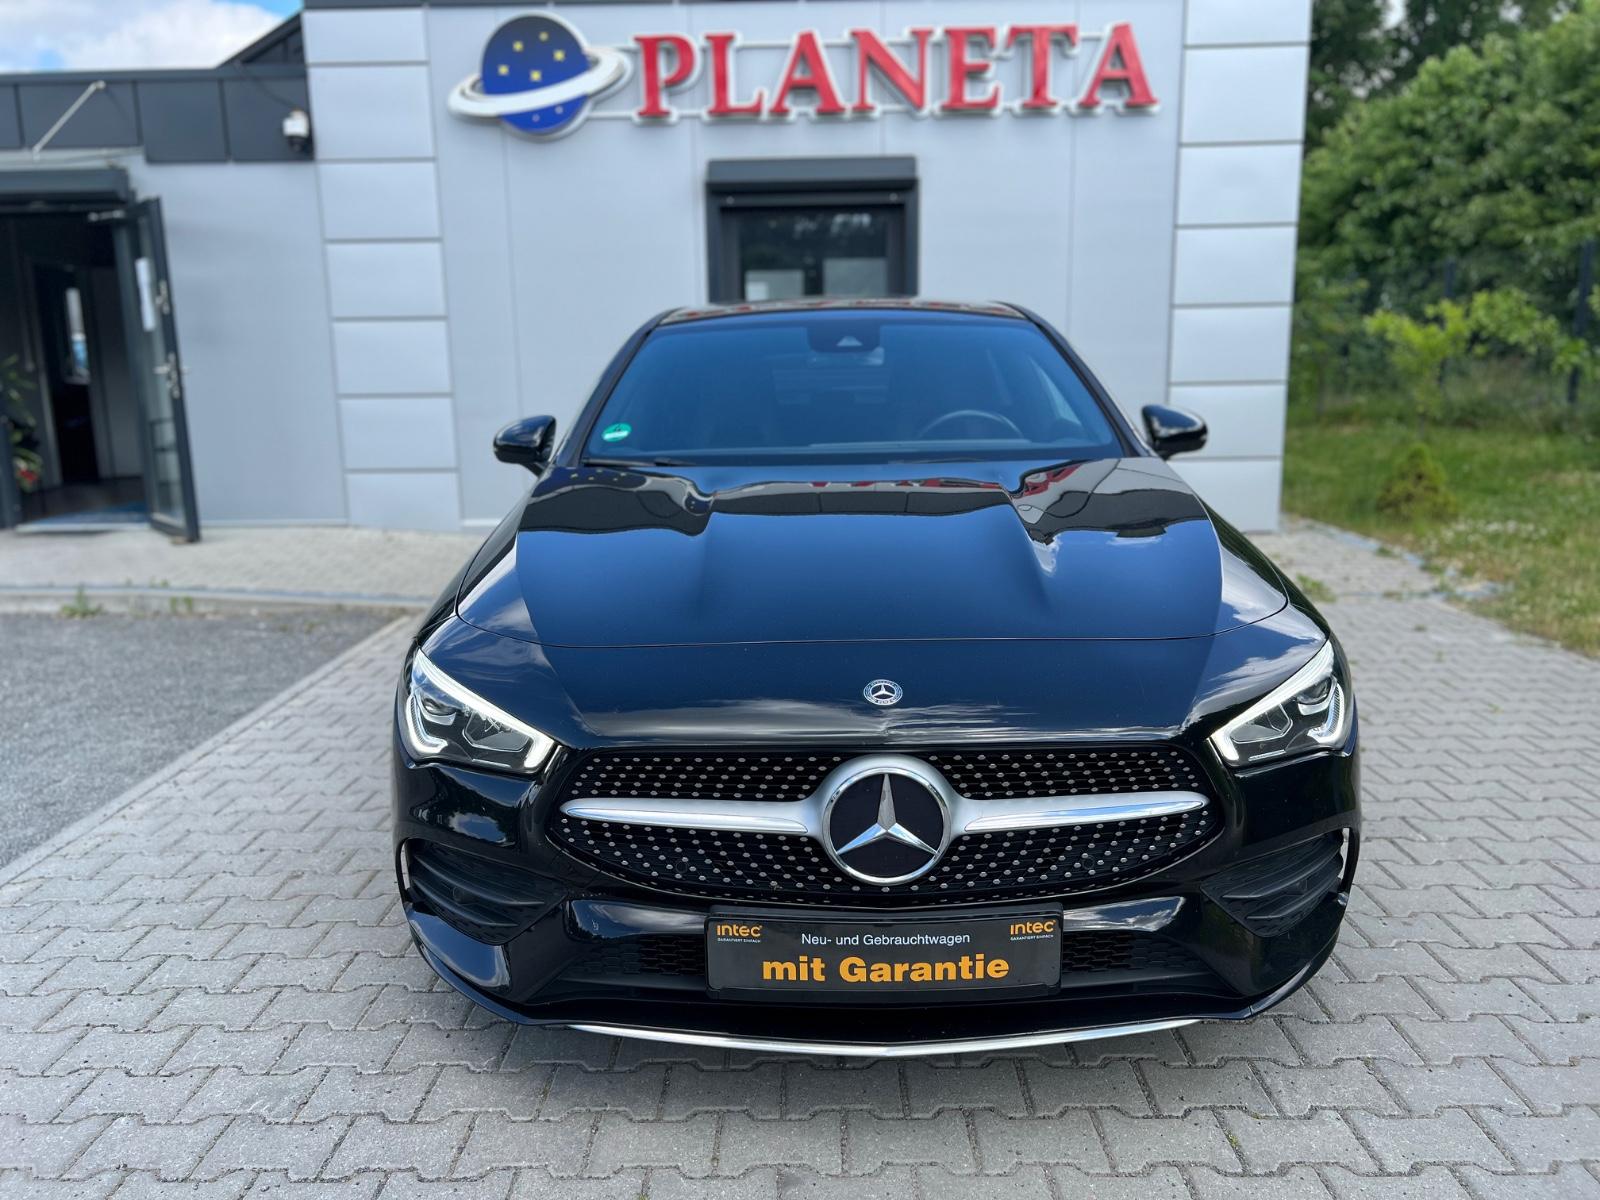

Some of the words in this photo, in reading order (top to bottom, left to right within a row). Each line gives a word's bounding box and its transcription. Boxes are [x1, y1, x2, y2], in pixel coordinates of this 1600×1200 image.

[633, 22, 1158, 119] PLANETA
[717, 924, 762, 937] intec
[1010, 920, 1055, 935] intec
[801, 933, 832, 945] Neu-
[835, 934, 859, 945] und
[863, 933, 970, 946] Gebrauchtwagen
[762, 956, 826, 981] mit
[839, 953, 1010, 982] Garantie
